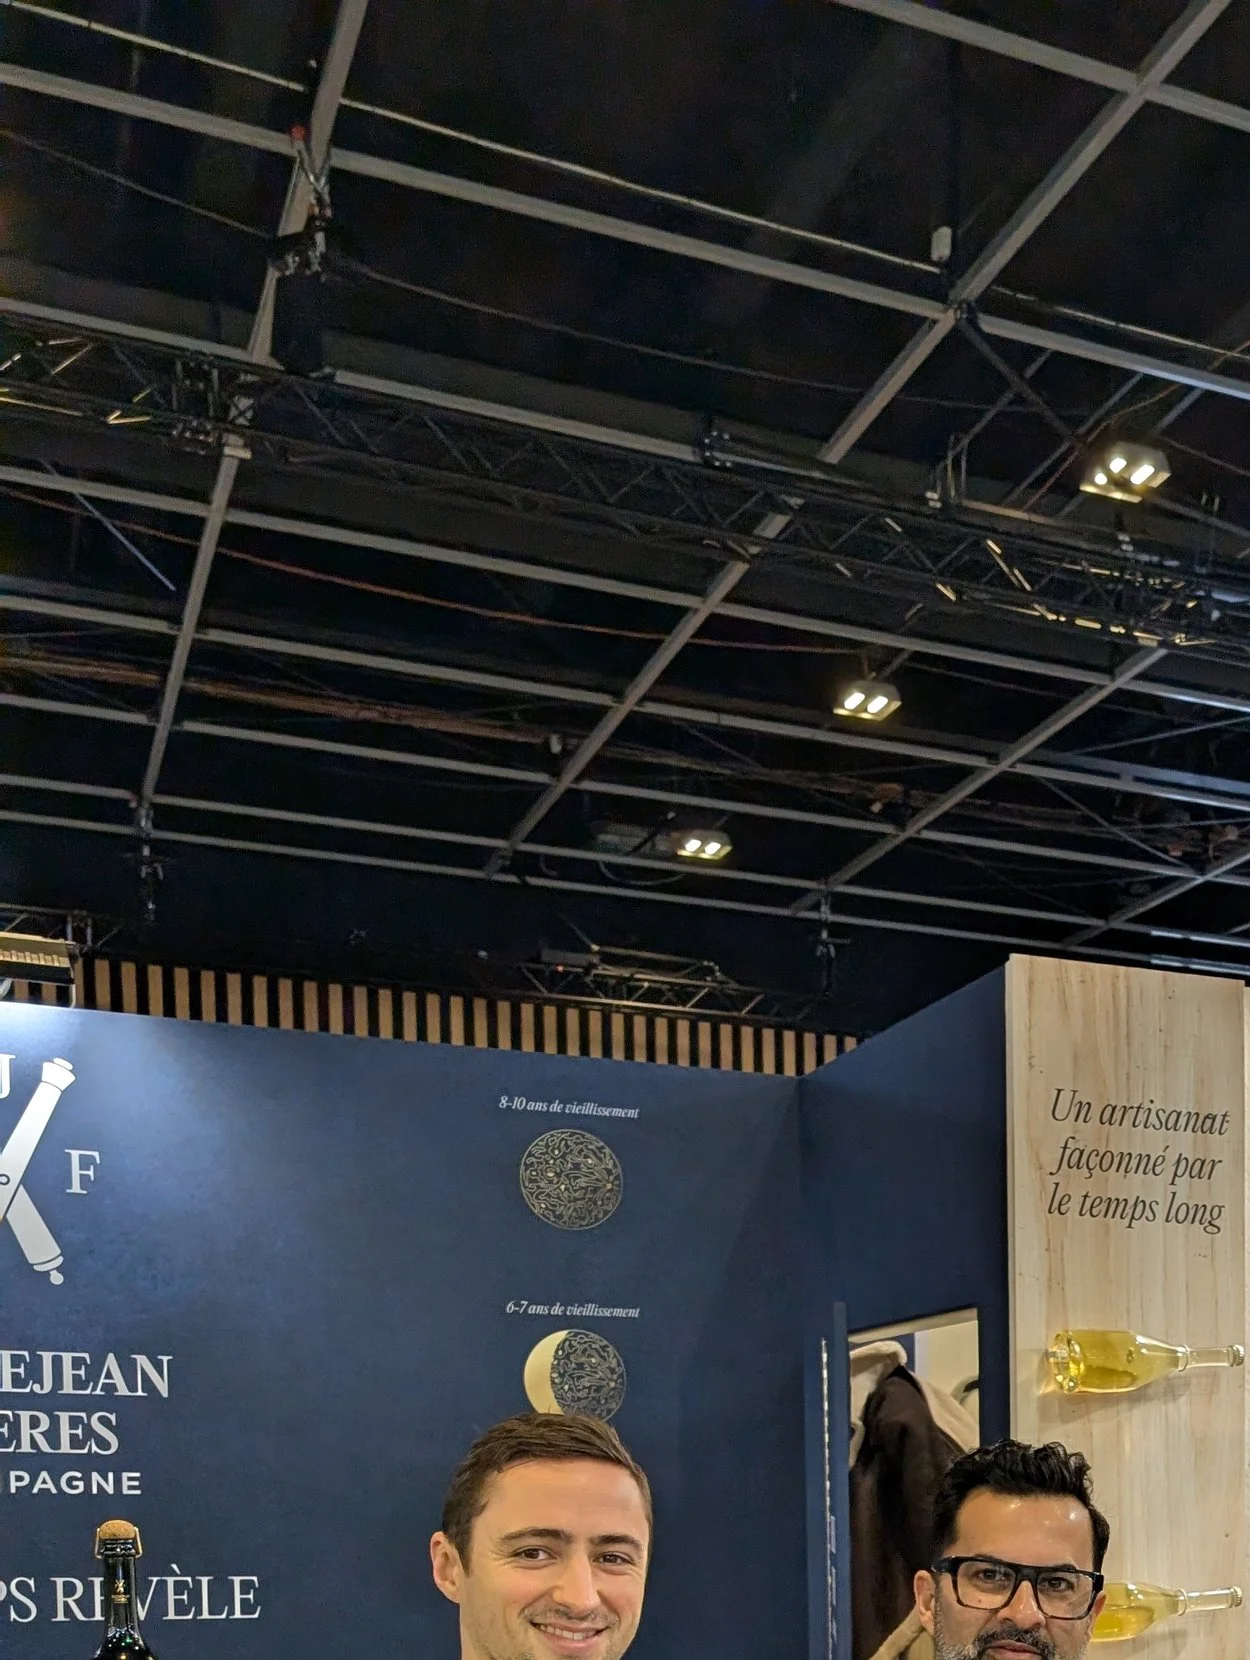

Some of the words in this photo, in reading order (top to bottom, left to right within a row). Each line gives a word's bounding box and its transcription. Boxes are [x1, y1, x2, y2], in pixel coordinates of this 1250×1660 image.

[499, 1095, 526, 1110] 8-10
[527, 1101, 548, 1112] ans
[549, 1099, 563, 1113] de
[564, 1102, 640, 1119] vieillissement
[1051, 1088, 1092, 1124] Un
[1099, 1099, 1230, 1136] artisanat
[64, 1149, 100, 1194] F
[1048, 1136, 1170, 1179] façonné
[1169, 1152, 1222, 1185] par
[1047, 1182, 1071, 1216] le
[1078, 1191, 1159, 1229] temps
[1165, 1191, 1225, 1235] long
[506, 1300, 528, 1314] 6-7
[528, 1304, 549, 1315] ans
[550, 1302, 565, 1315] de
[566, 1303, 640, 1318] vieillissement
